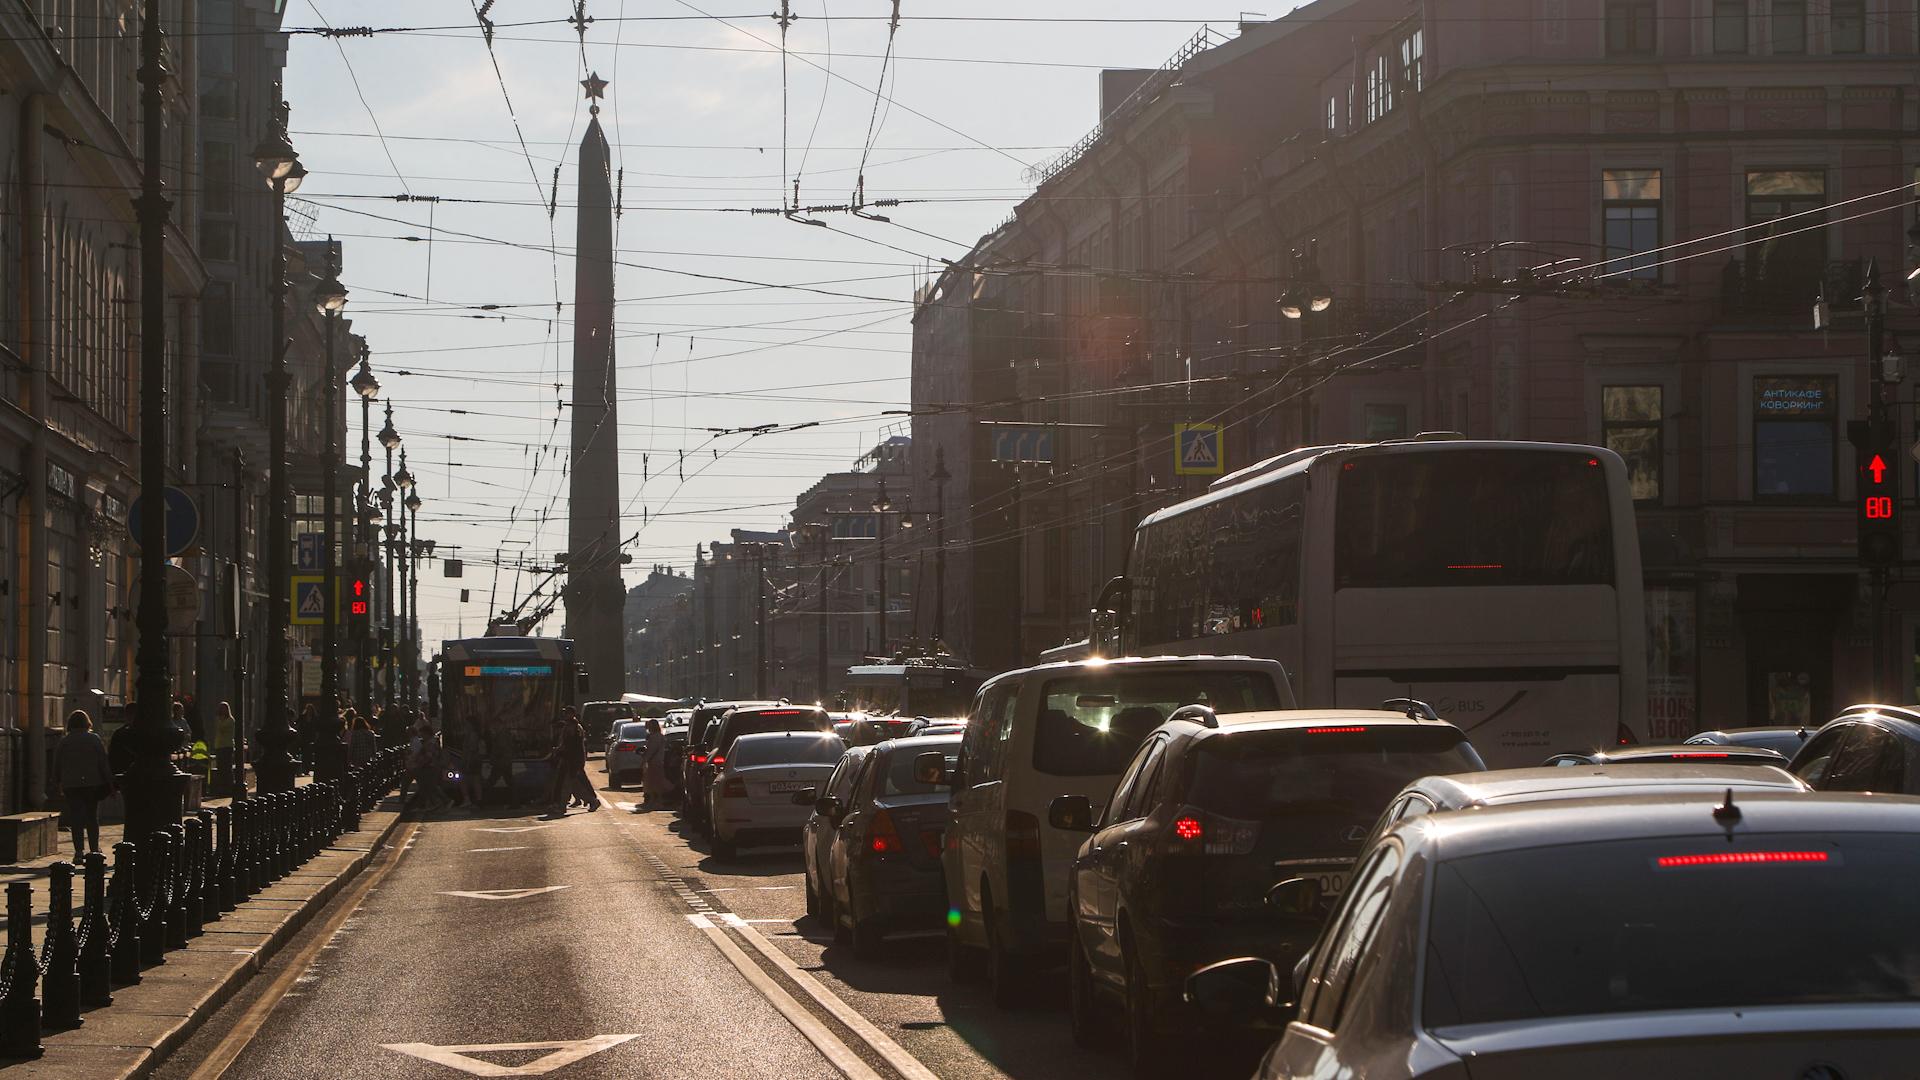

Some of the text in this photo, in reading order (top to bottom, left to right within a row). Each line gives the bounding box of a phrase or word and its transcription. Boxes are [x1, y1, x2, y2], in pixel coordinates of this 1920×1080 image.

[1762, 389, 1822, 399] АНТИКАФЕ
[1760, 400, 1825, 410] КОВОРКИНГ
[1866, 496, 1892, 518] 80
[352, 601, 367, 614] 80
[1458, 700, 1485, 712] BUS
